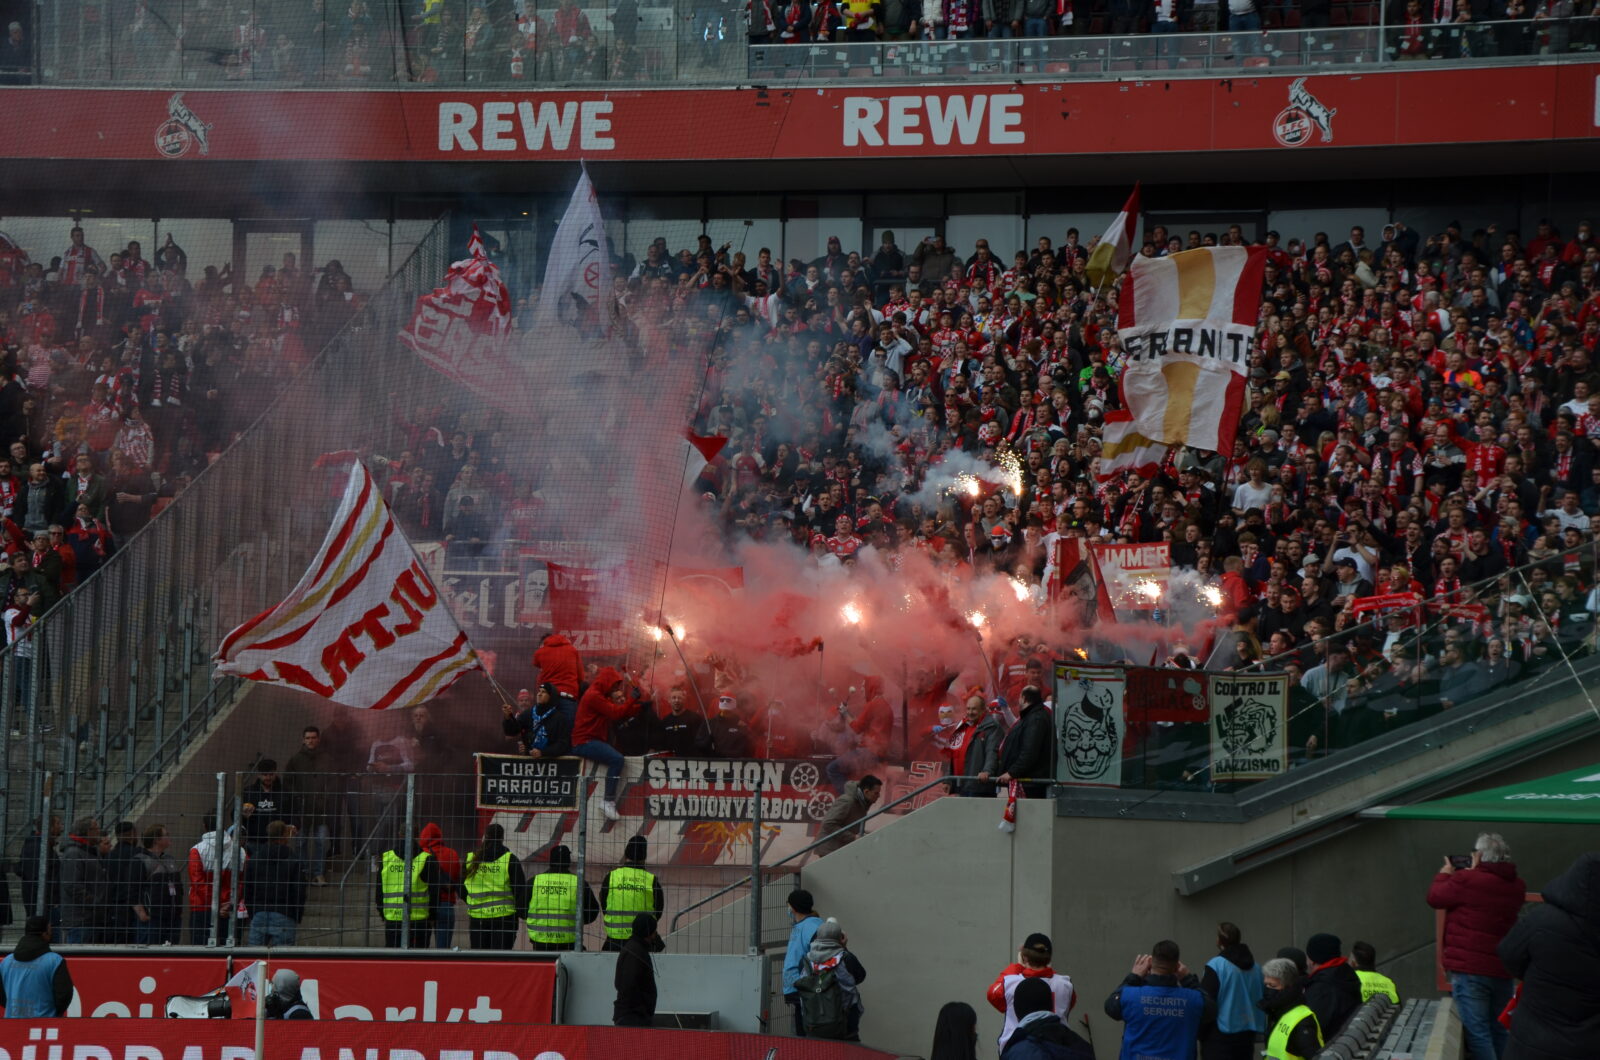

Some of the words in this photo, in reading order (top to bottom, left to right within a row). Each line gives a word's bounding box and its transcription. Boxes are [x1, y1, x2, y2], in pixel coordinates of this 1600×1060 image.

[438, 101, 616, 151] REWE
[843, 94, 1026, 147] REWE
[1215, 681, 1266, 697] CONTRO
[1268, 681, 1281, 696] IL
[501, 762, 559, 777] CURVA
[1215, 758, 1281, 774] RAZZISMO
[647, 759, 786, 793] SEKTION
[487, 778, 572, 795] PARADISO
[649, 793, 809, 821] STADIONVERBOT
[389, 864, 416, 873] ORDR
[540, 885, 568, 896] ORDNER
[617, 883, 645, 893] ORDNER
[1140, 995, 1188, 1007] SECURITY
[1143, 1006, 1185, 1018] SERVICE
